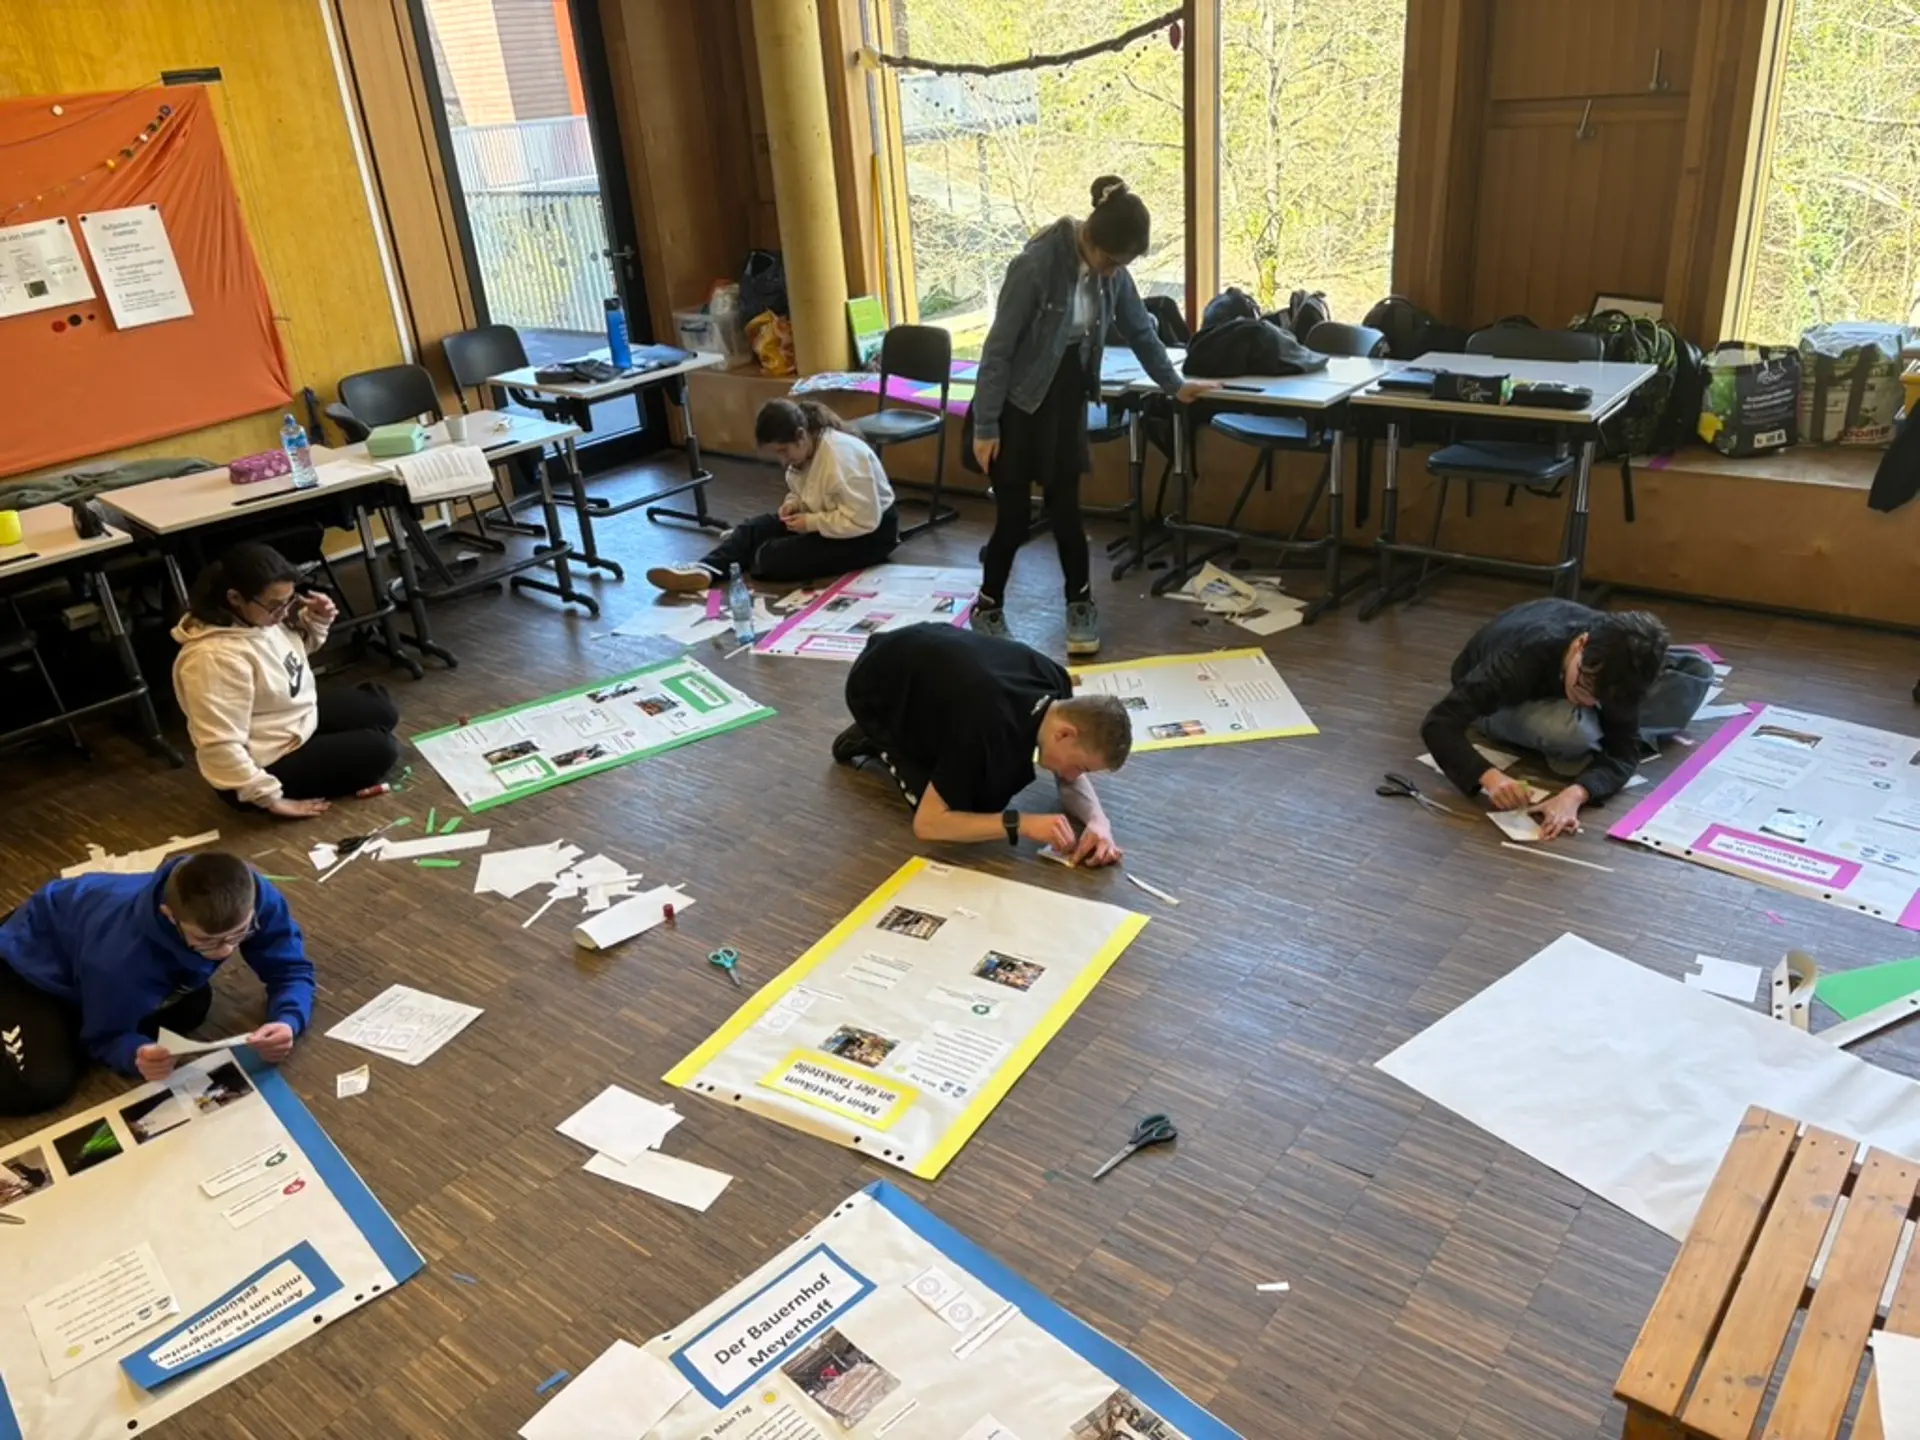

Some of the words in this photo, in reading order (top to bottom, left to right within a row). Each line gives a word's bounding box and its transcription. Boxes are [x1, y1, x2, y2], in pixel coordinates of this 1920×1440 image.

[784, 1075, 846, 1103] Praktikum
[793, 1061, 855, 1091] Tankstelle
[855, 1082, 879, 1096] der
[847, 1097, 881, 1115] Mein
[878, 1091, 897, 1103] an
[272, 1273, 303, 1297] mich
[187, 1285, 259, 1335] gekümmert
[249, 1294, 271, 1311] um
[713, 1335, 749, 1366] Der
[746, 1272, 833, 1341] Bauernhof
[746, 1297, 835, 1368] Meyerhoff
[712, 1415, 737, 1437] Mein
[734, 1405, 753, 1420] Tag
